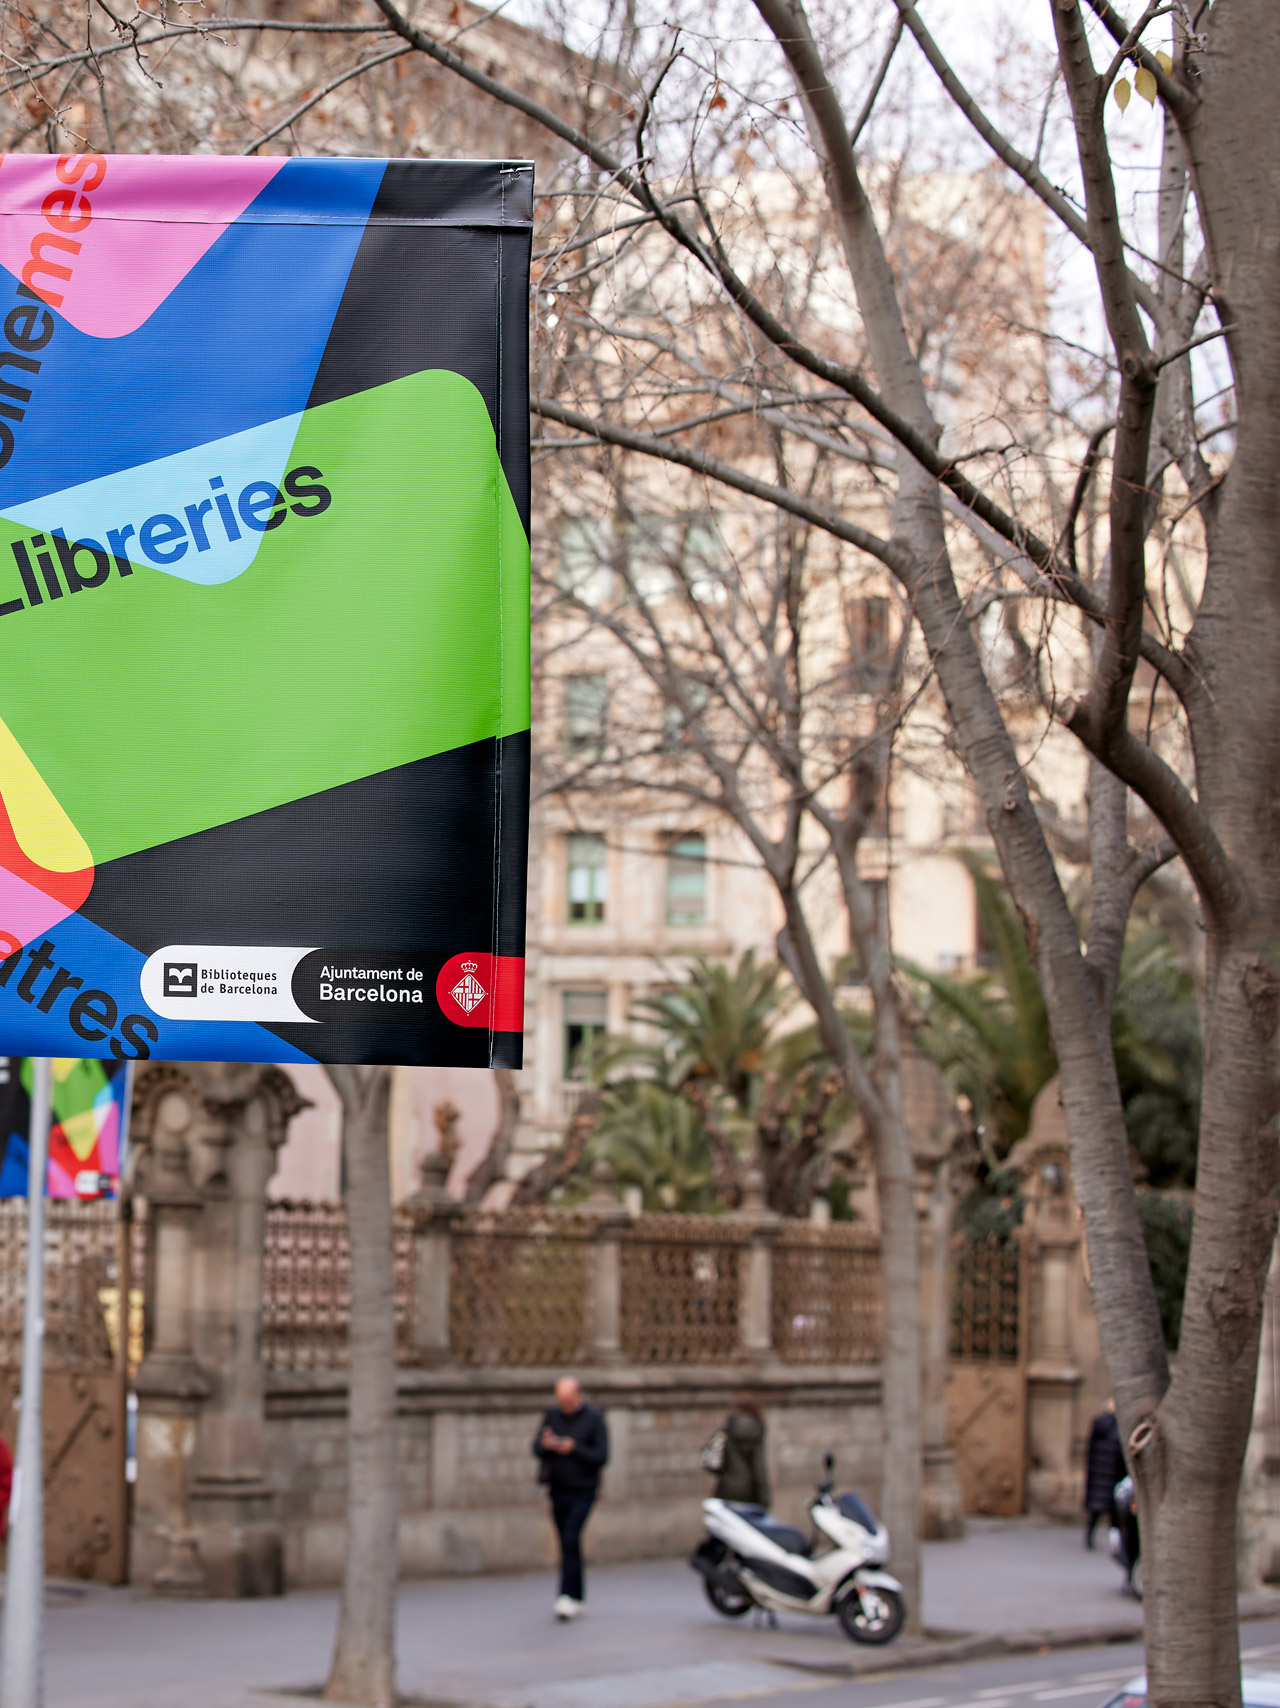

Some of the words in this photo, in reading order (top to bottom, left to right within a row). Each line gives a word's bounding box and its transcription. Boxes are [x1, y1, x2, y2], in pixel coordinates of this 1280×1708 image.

[201, 968, 278, 983] Biblioteques
[319, 965, 403, 982] Ajuntament
[405, 967, 424, 982] de
[200, 982, 215, 994] de
[219, 983, 279, 996] Barcelona
[319, 983, 424, 1004] Barcelona
